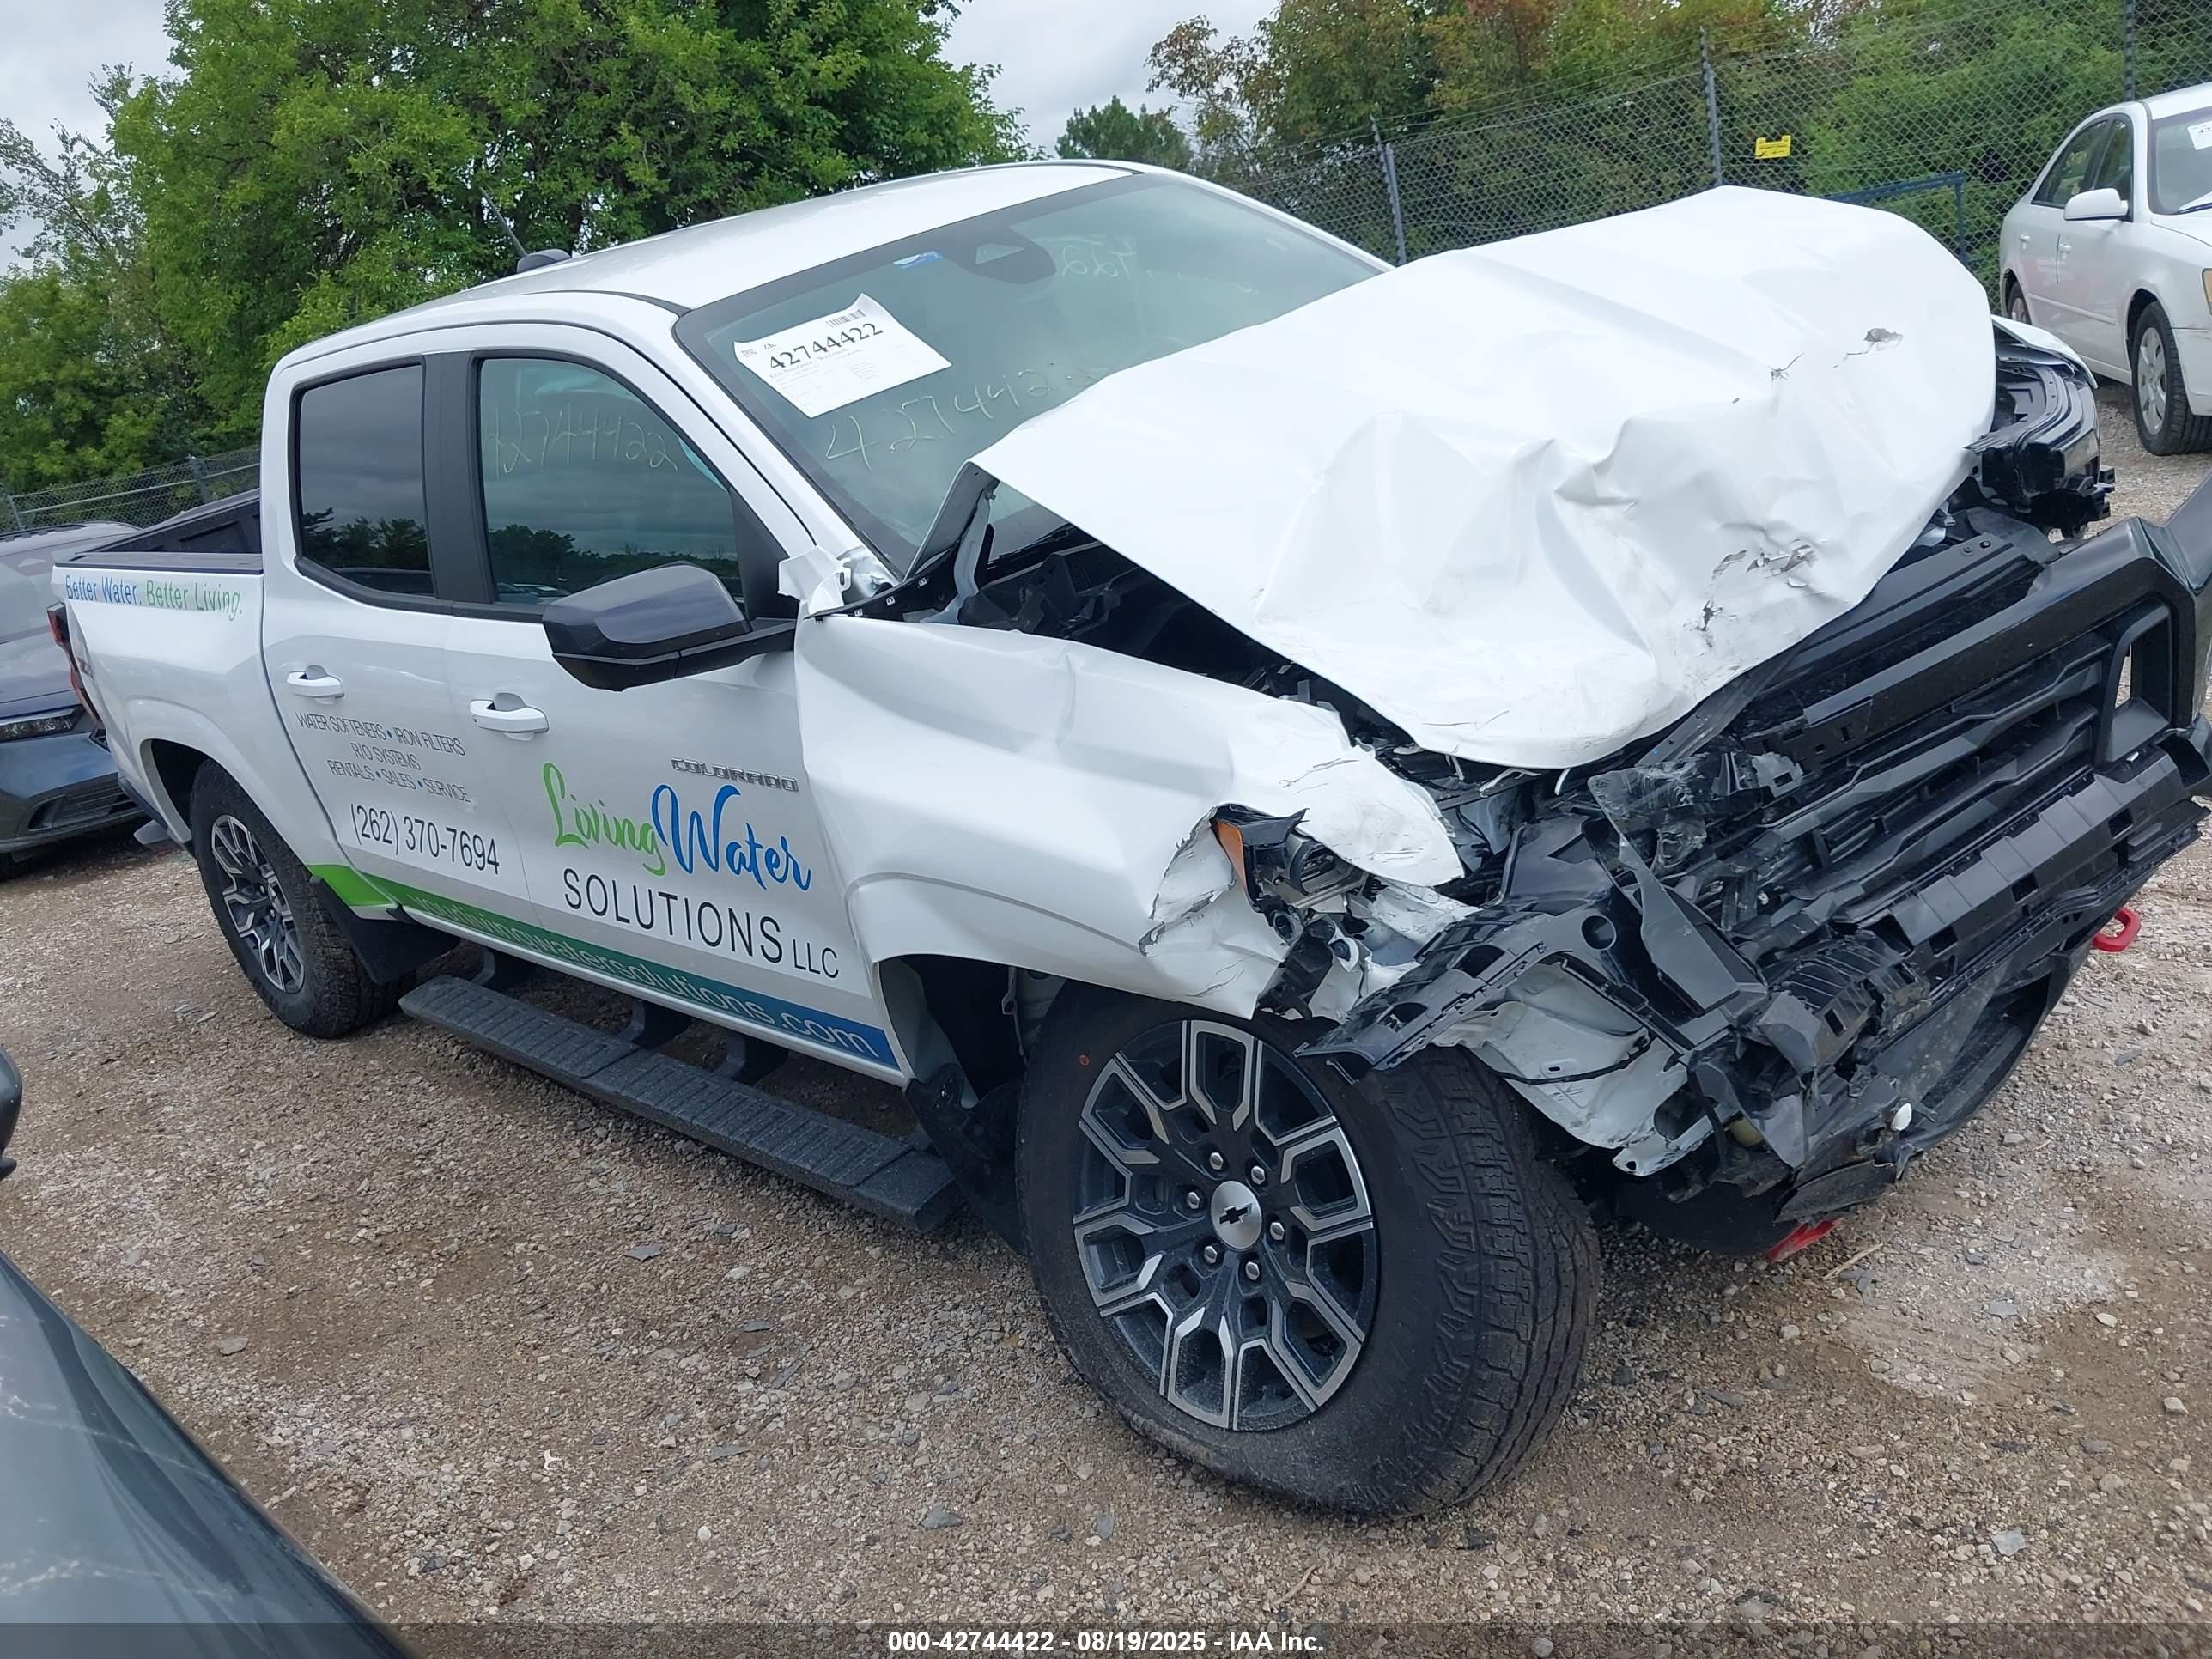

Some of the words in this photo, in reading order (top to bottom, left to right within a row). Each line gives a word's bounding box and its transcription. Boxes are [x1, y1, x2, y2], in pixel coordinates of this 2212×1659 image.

[769, 322, 884, 369] 42744422
[65, 574, 97, 601] Better
[101, 576, 142, 605] Water.
[146, 579, 189, 610] Better
[194, 582, 243, 622] Living.
[295, 712, 331, 732] WATER
[329, 715, 387, 741] SOFTENERS
[392, 726, 423, 748] IRON
[420, 732, 465, 757] FILTERS
[327, 759, 376, 781] RENTALS
[380, 769, 417, 790] SALES
[422, 777, 472, 804] SERVICE
[372, 746, 422, 771] SYSTEMS
[670, 757, 799, 793] COLORADO
[350, 803, 399, 856] (262)
[404, 815, 501, 875] 370-7694
[542, 761, 666, 878] Living
[650, 783, 812, 891] Water
[563, 868, 784, 964] SOLUTIONS
[792, 938, 840, 979] LLC
